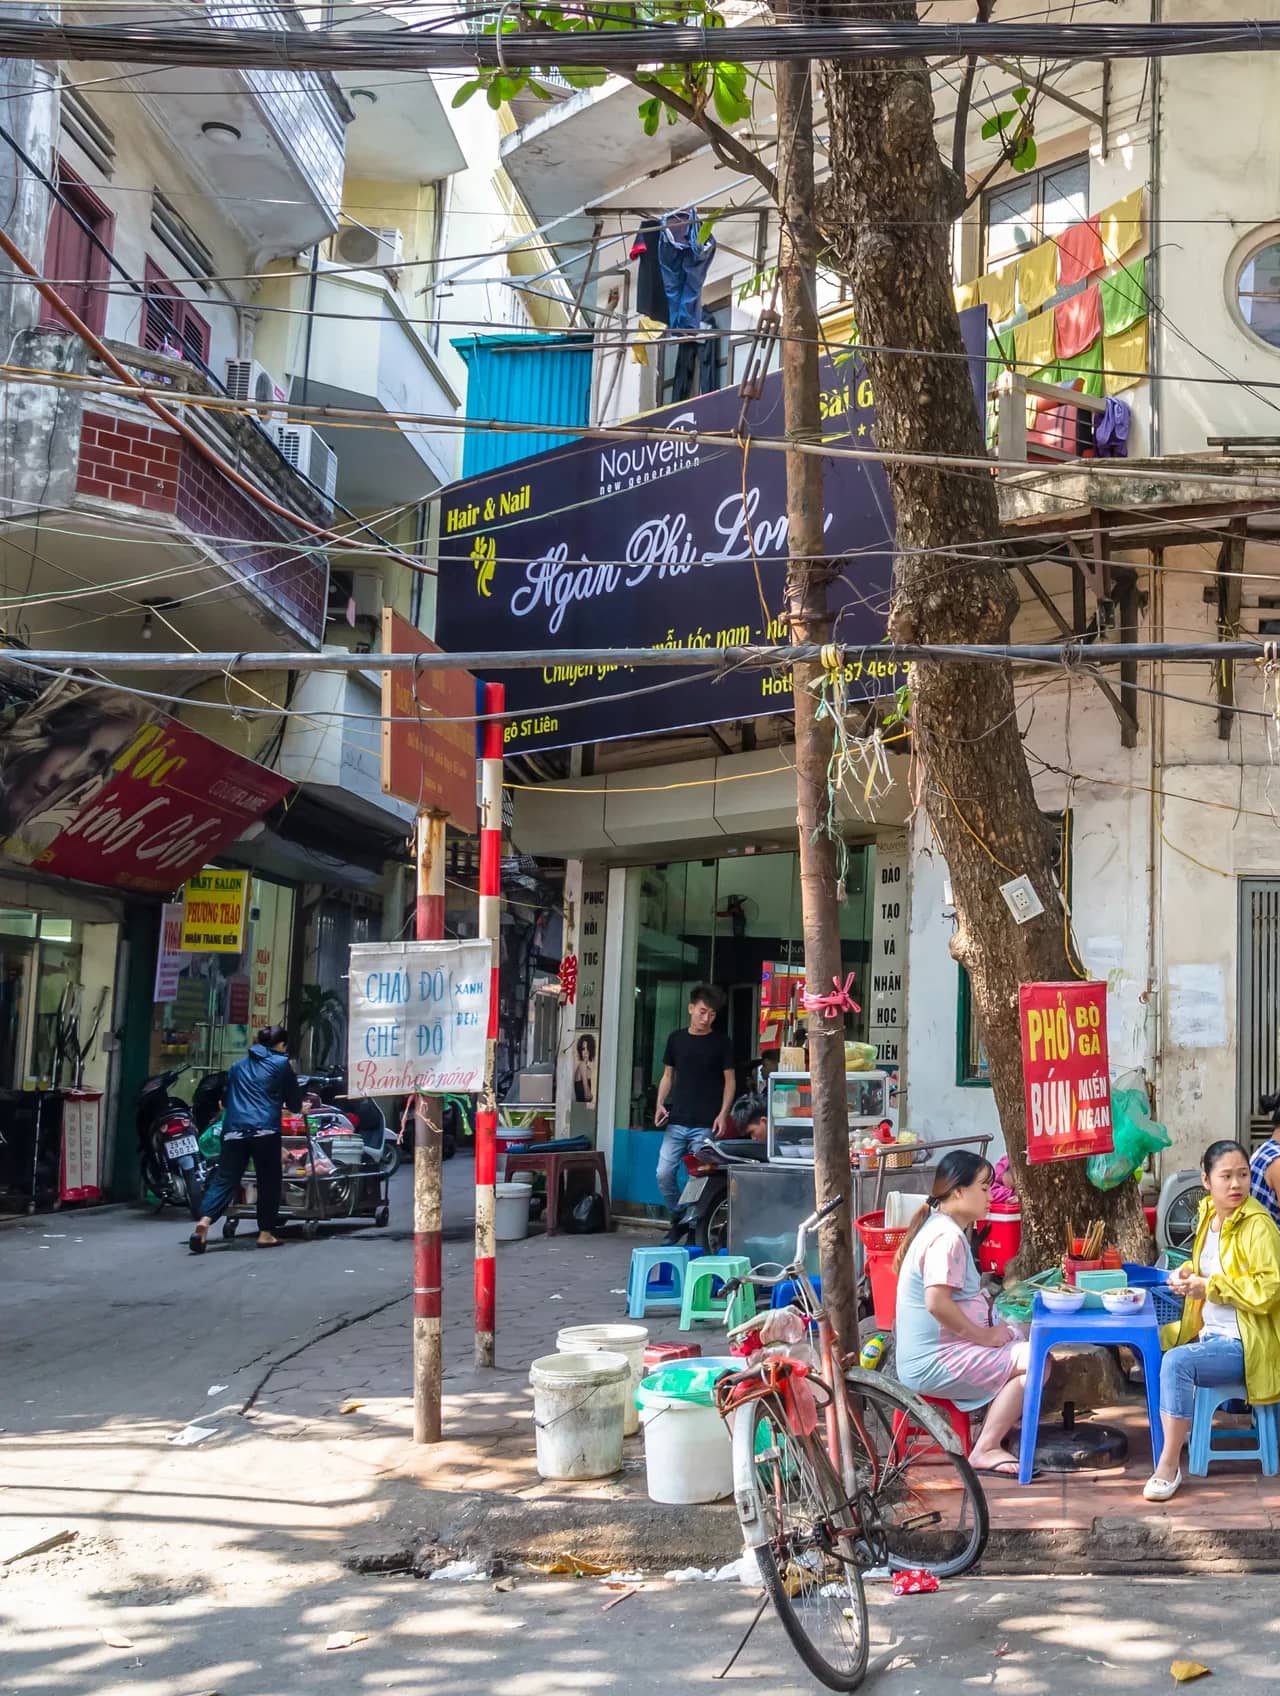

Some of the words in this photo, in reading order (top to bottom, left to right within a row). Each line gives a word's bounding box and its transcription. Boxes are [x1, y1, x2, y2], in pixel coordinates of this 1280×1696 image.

[599, 479, 622, 495] new
[628, 457, 700, 489] generation
[447, 504, 480, 533] Hair
[483, 497, 496, 521] &
[499, 485, 531, 516] Nail
[511, 542, 622, 634] Ngàn
[625, 513, 697, 587] Phi
[716, 624, 751, 648] nam
[504, 722, 519, 743] gô
[534, 714, 558, 734] Liên
[215, 877, 242, 889] SALON
[881, 862, 901, 885] ĐÀO
[882, 902, 900, 924] TẠO
[883, 934, 896, 956] VÀ
[366, 965, 411, 1004] CHÁO
[455, 982, 484, 995] XANH
[873, 970, 902, 996] NHẬN
[877, 1007, 897, 1028] HỌC
[1027, 991, 1070, 1062] PHỞ
[1075, 1000, 1100, 1029] BÒ
[1078, 1028, 1101, 1056] GÀ
[1030, 1067, 1071, 1137] BÚN
[1077, 1105, 1110, 1131] NGAN
